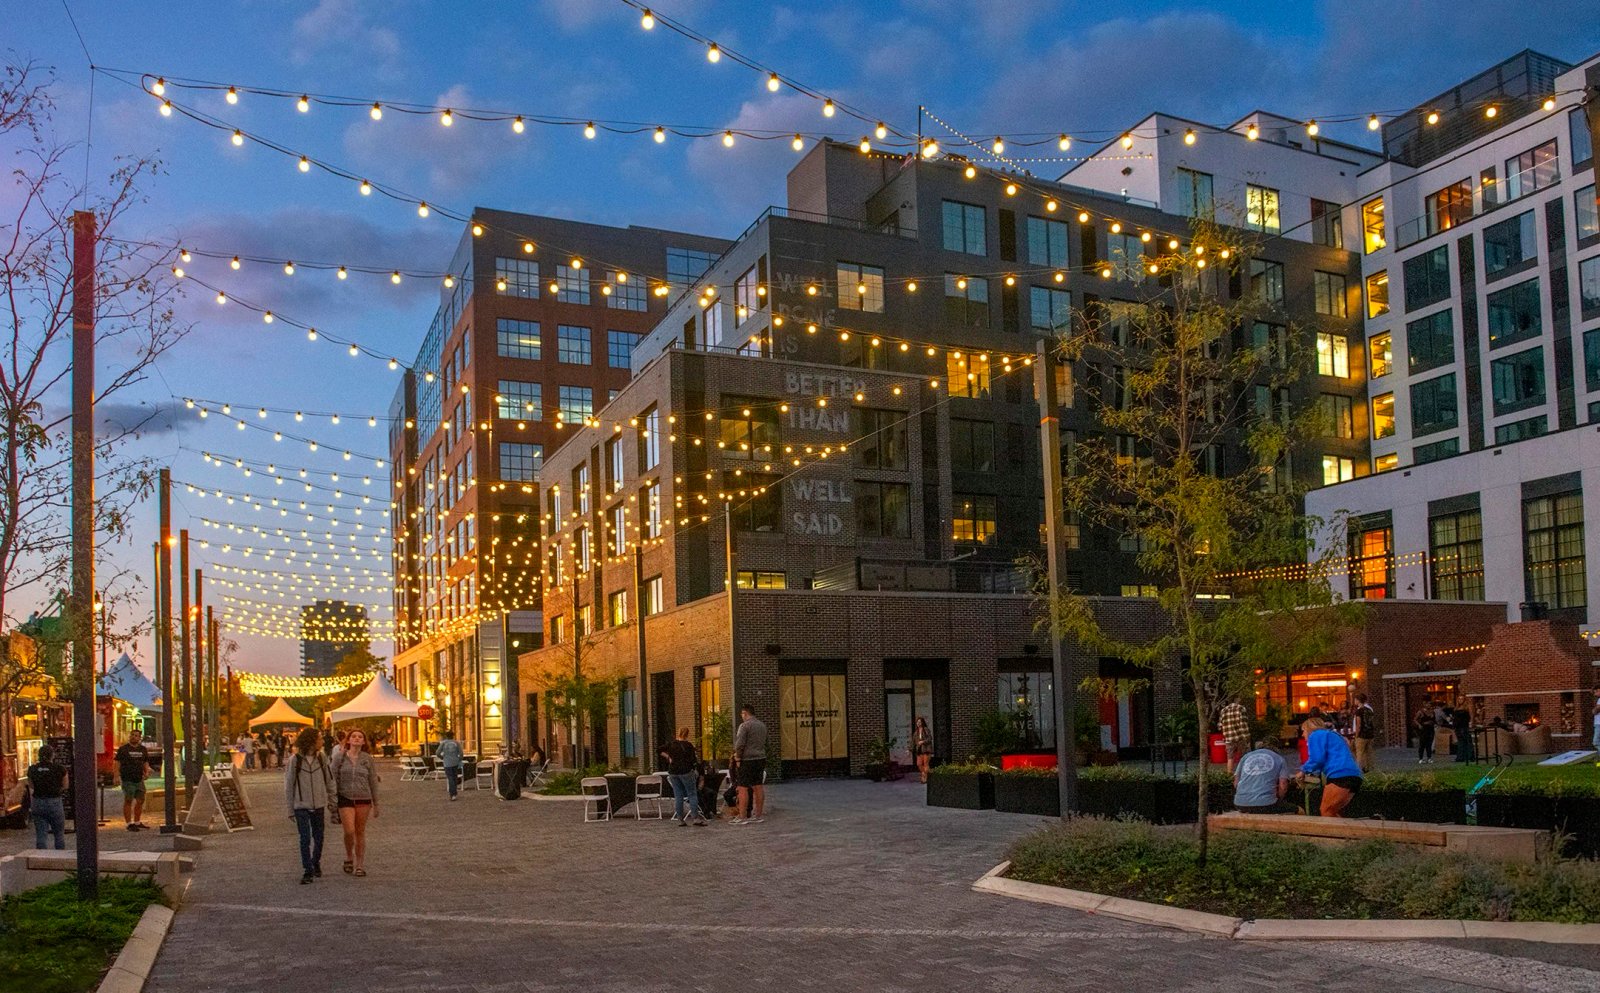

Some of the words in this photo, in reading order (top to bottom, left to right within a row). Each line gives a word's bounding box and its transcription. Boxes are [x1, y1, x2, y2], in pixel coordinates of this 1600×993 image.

[781, 334, 799, 354] IS
[786, 372, 865, 400] BETTER
[788, 406, 850, 433] THAN
[790, 479, 852, 503] WELL
[793, 511, 843, 535] SAID
